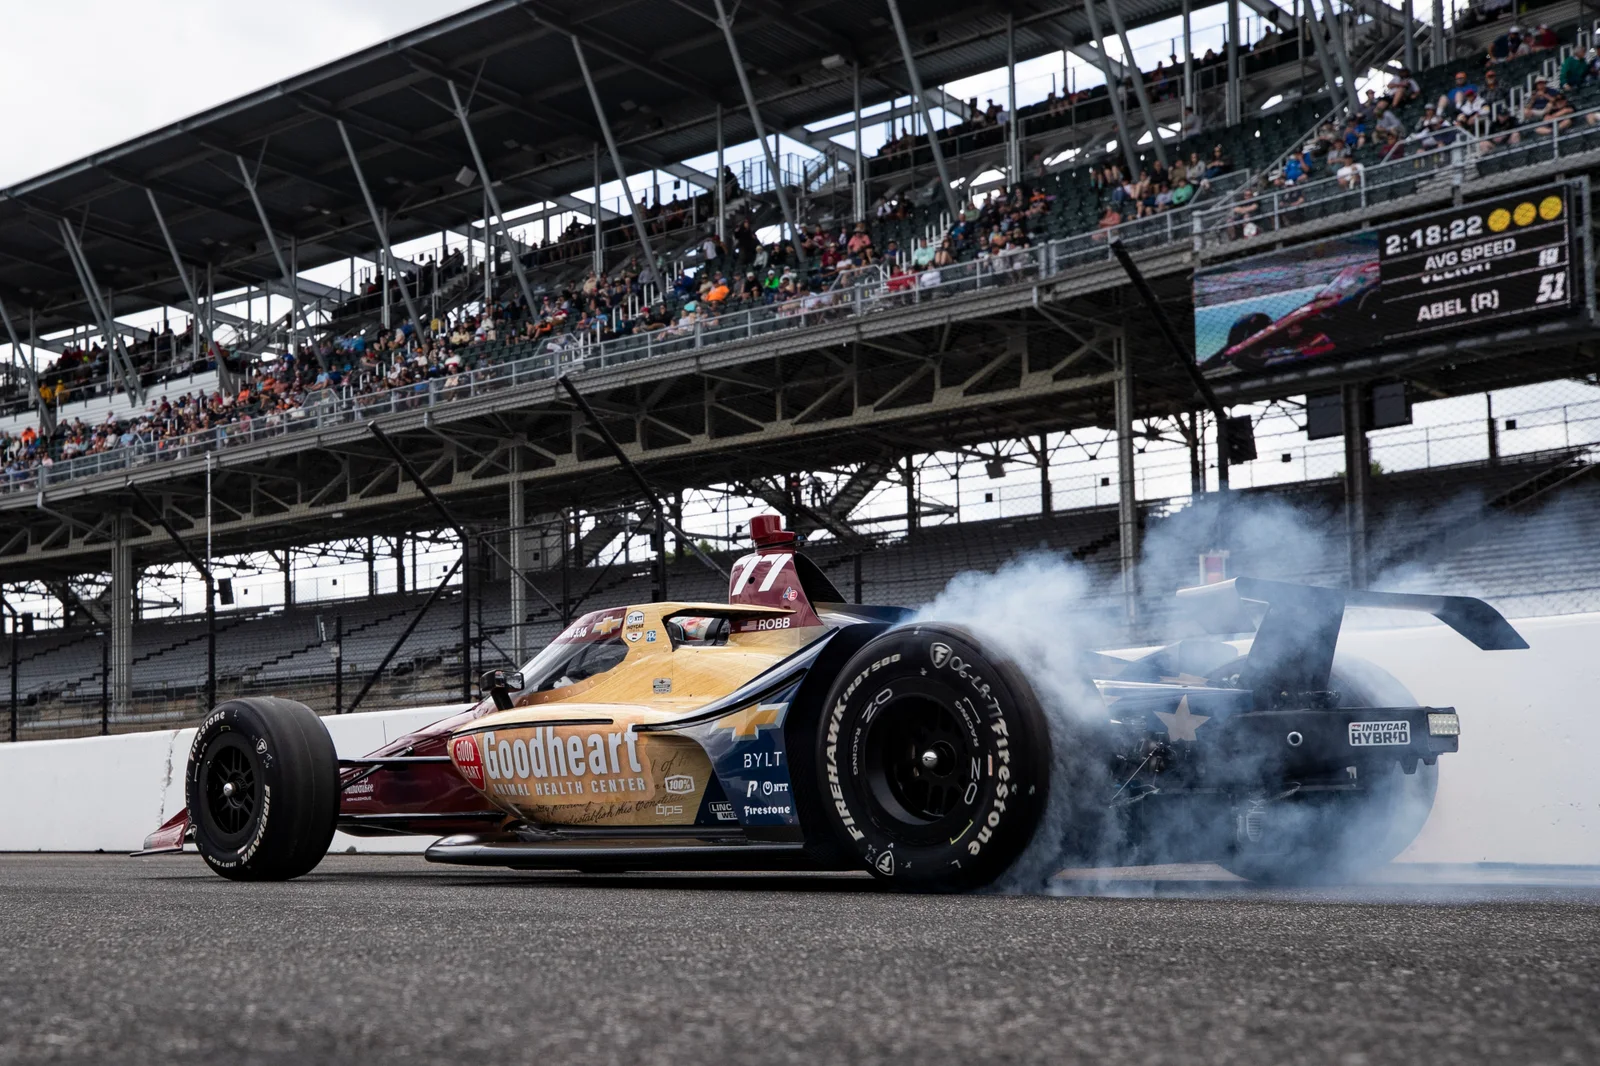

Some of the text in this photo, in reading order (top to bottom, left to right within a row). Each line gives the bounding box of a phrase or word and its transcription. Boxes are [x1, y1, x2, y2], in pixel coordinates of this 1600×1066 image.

[1386, 216, 1483, 255] 2:18:22
[1424, 238, 1516, 271] AVG SPEED
[1417, 298, 1467, 322] ABEL
[731, 553, 793, 597] 77
[758, 617, 790, 630] ROBB
[190, 711, 225, 761] Firestone
[955, 700, 979, 747] RACING
[1362, 722, 1407, 732] INDYCAR
[456, 740, 474, 761] GOOD
[483, 723, 641, 780] Goodheart
[744, 751, 782, 768] BYLT
[852, 727, 862, 776] RACING
[669, 779, 691, 790] 100%
[827, 696, 865, 841] FIREHAWK
[493, 784, 530, 796] ANIMAL
[536, 781, 583, 796] HEALTH
[591, 777, 646, 793] CENTER
[773, 783, 788, 792] NTT
[968, 718, 1010, 856] Firestone
[241, 784, 270, 865] FIREHAWK
[743, 805, 791, 817] Firestone
